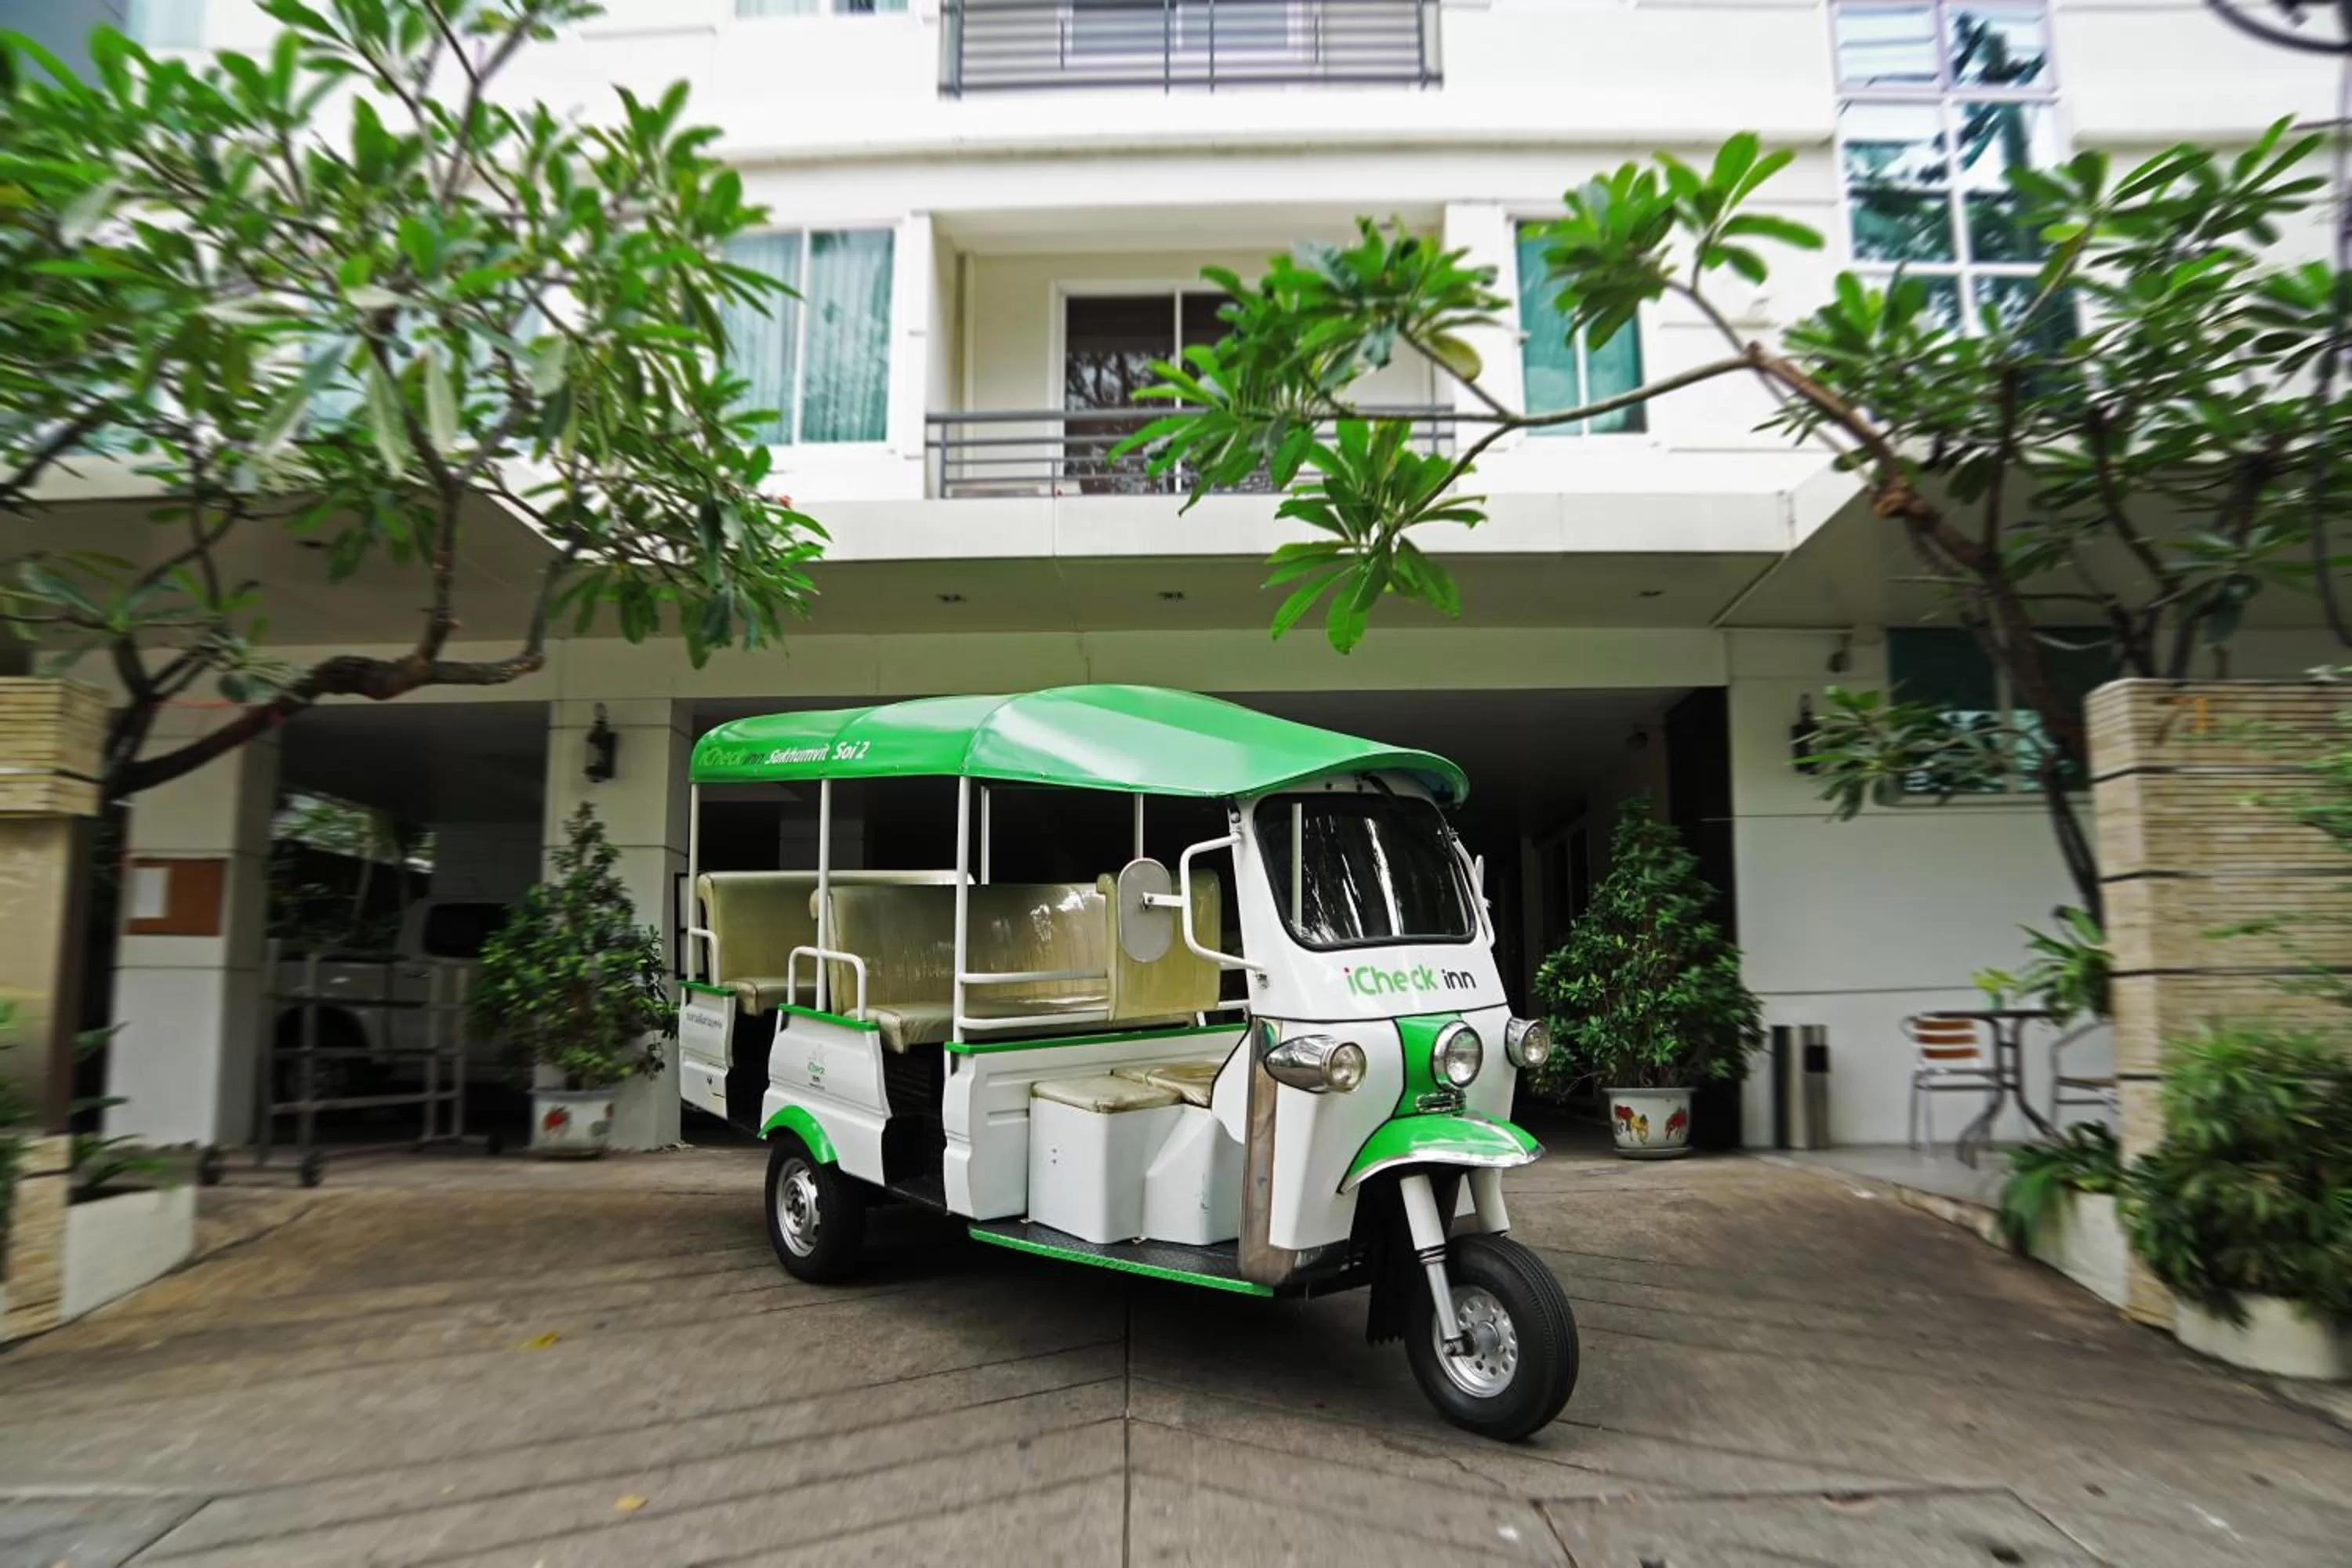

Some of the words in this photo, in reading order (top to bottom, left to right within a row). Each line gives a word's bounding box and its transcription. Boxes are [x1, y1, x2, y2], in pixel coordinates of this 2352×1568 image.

[832, 740, 860, 760] Soi
[855, 741, 870, 759] 2
[1343, 964, 1439, 996] iCheck
[1441, 968, 1477, 989] inn
